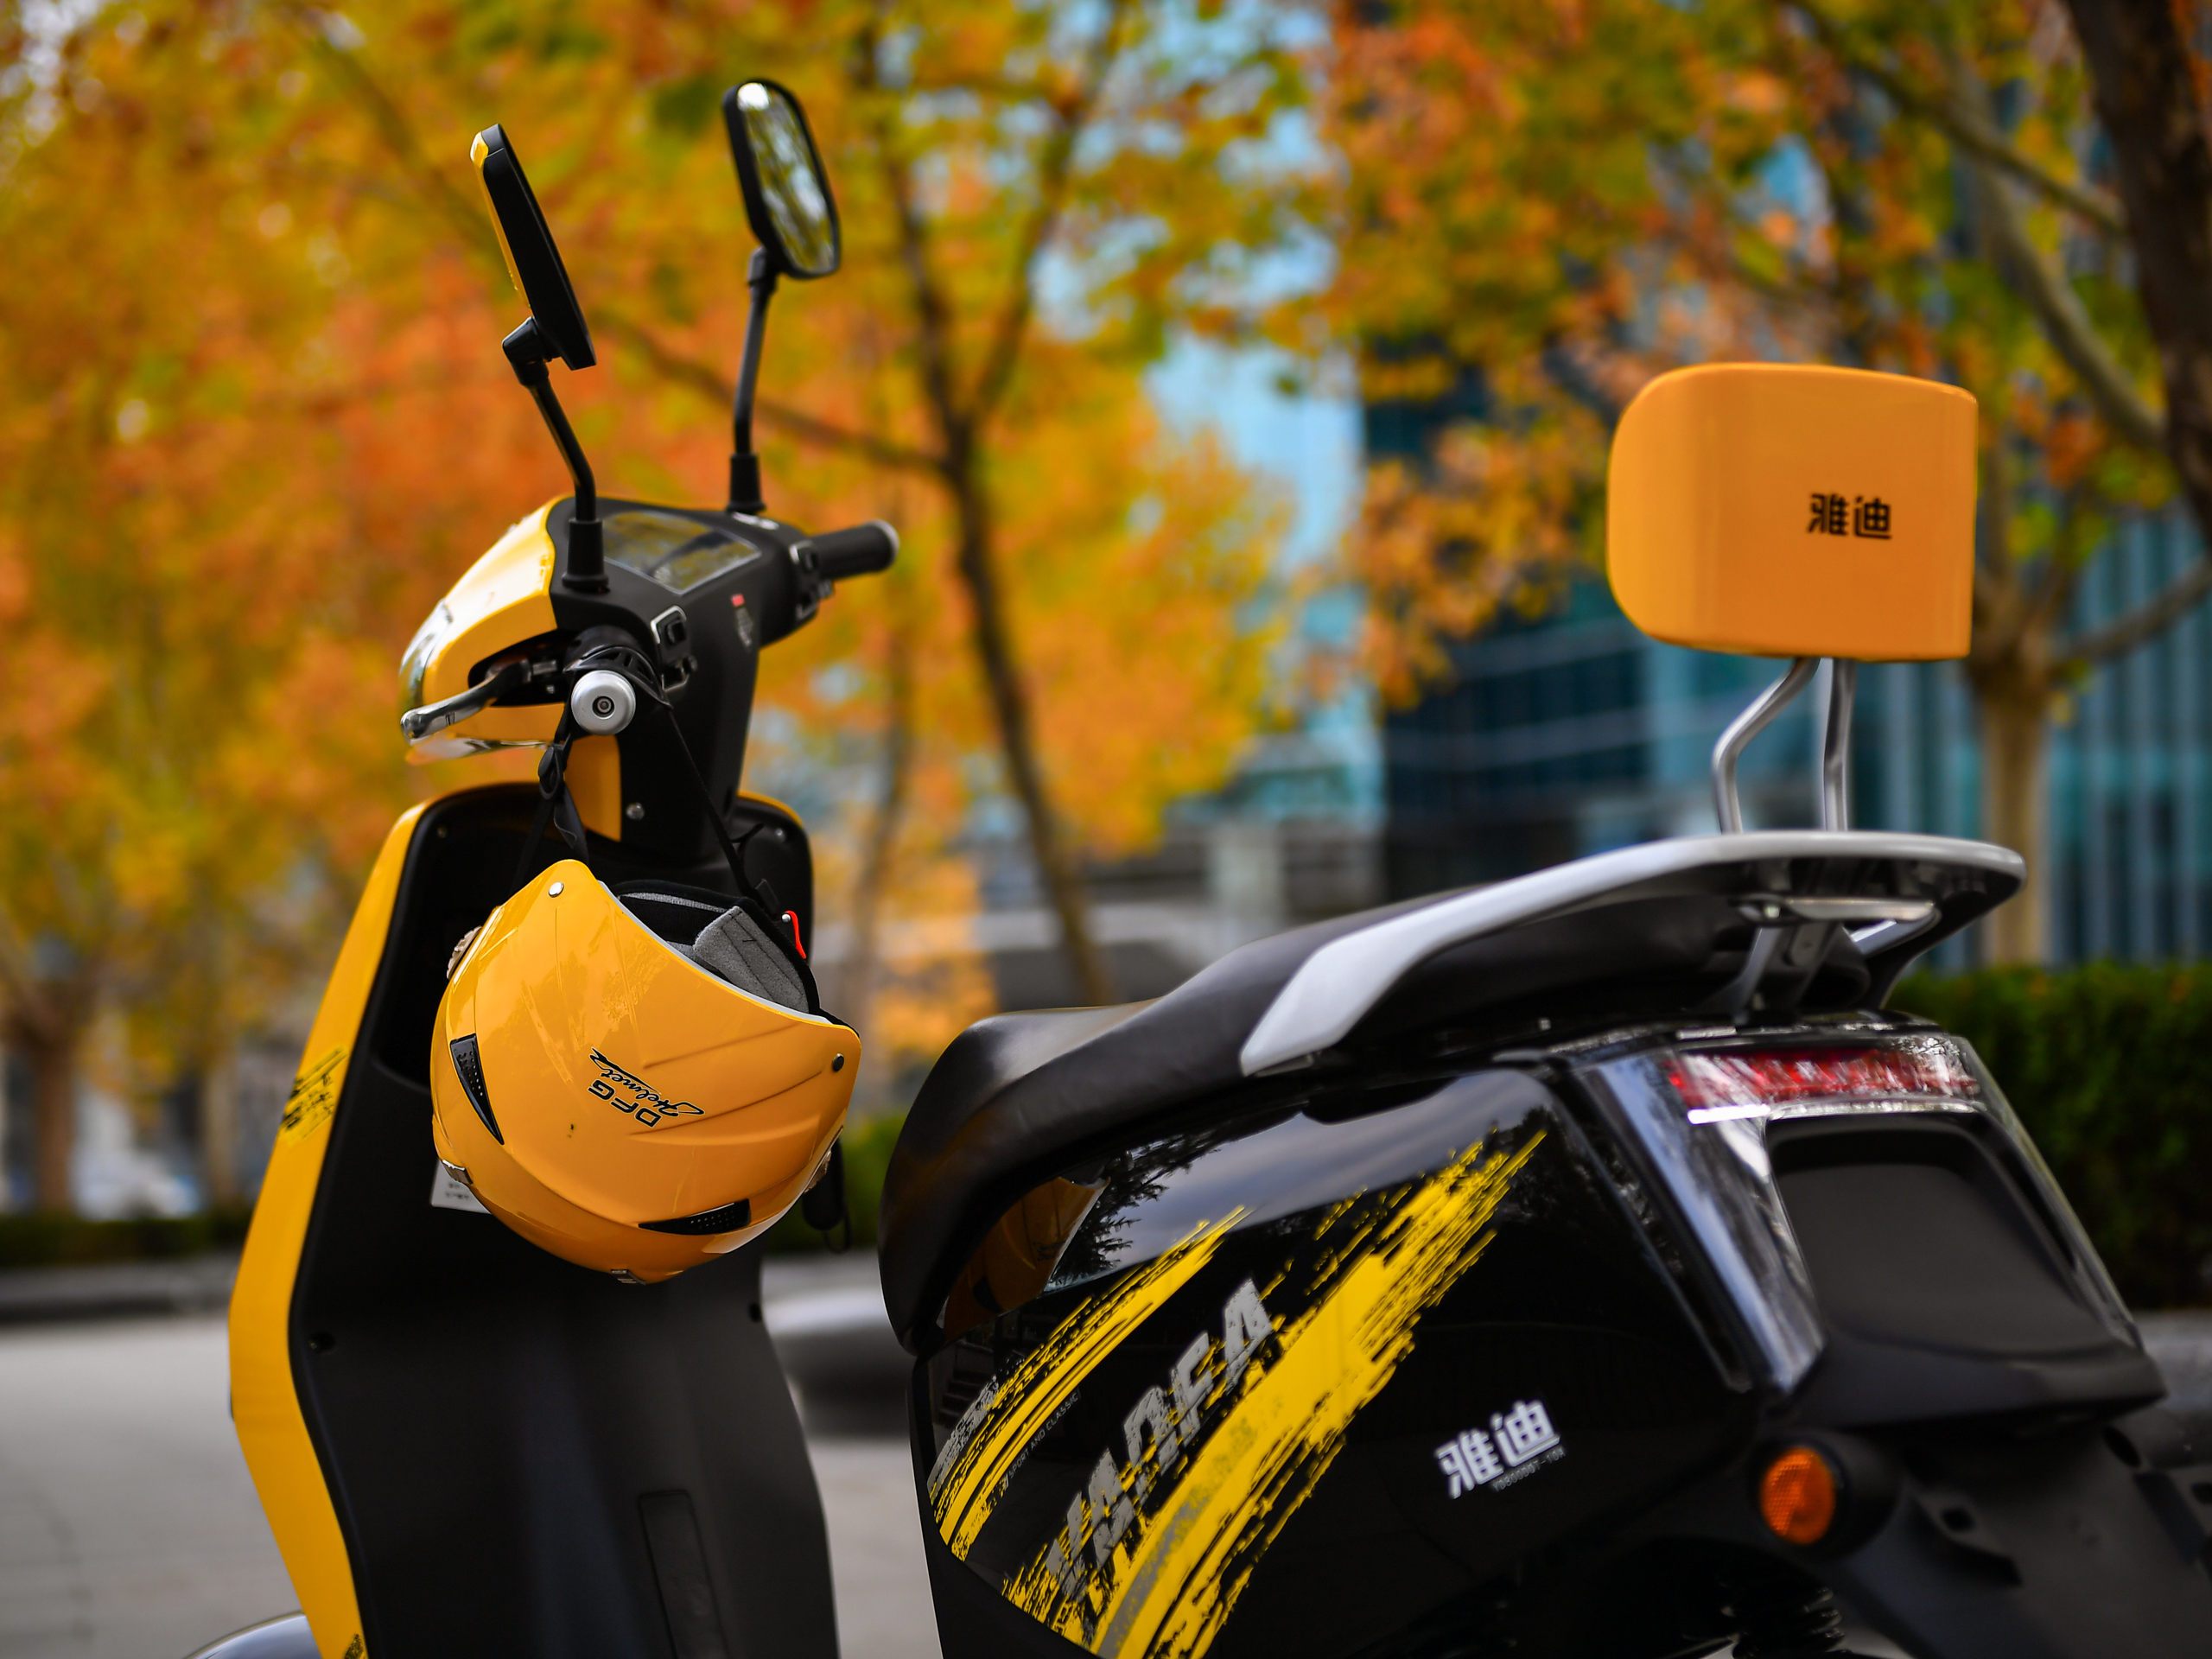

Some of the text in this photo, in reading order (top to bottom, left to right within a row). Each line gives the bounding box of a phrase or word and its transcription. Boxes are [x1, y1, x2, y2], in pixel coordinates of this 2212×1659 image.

[1807, 493, 1892, 540] 雅迪
[587, 1079, 663, 1128] DFG
[594, 1060, 704, 1117] Helmet
[1008, 1392, 1078, 1478] SPORT AND CLASSIC
[1433, 1399, 1560, 1500] 雅迪
